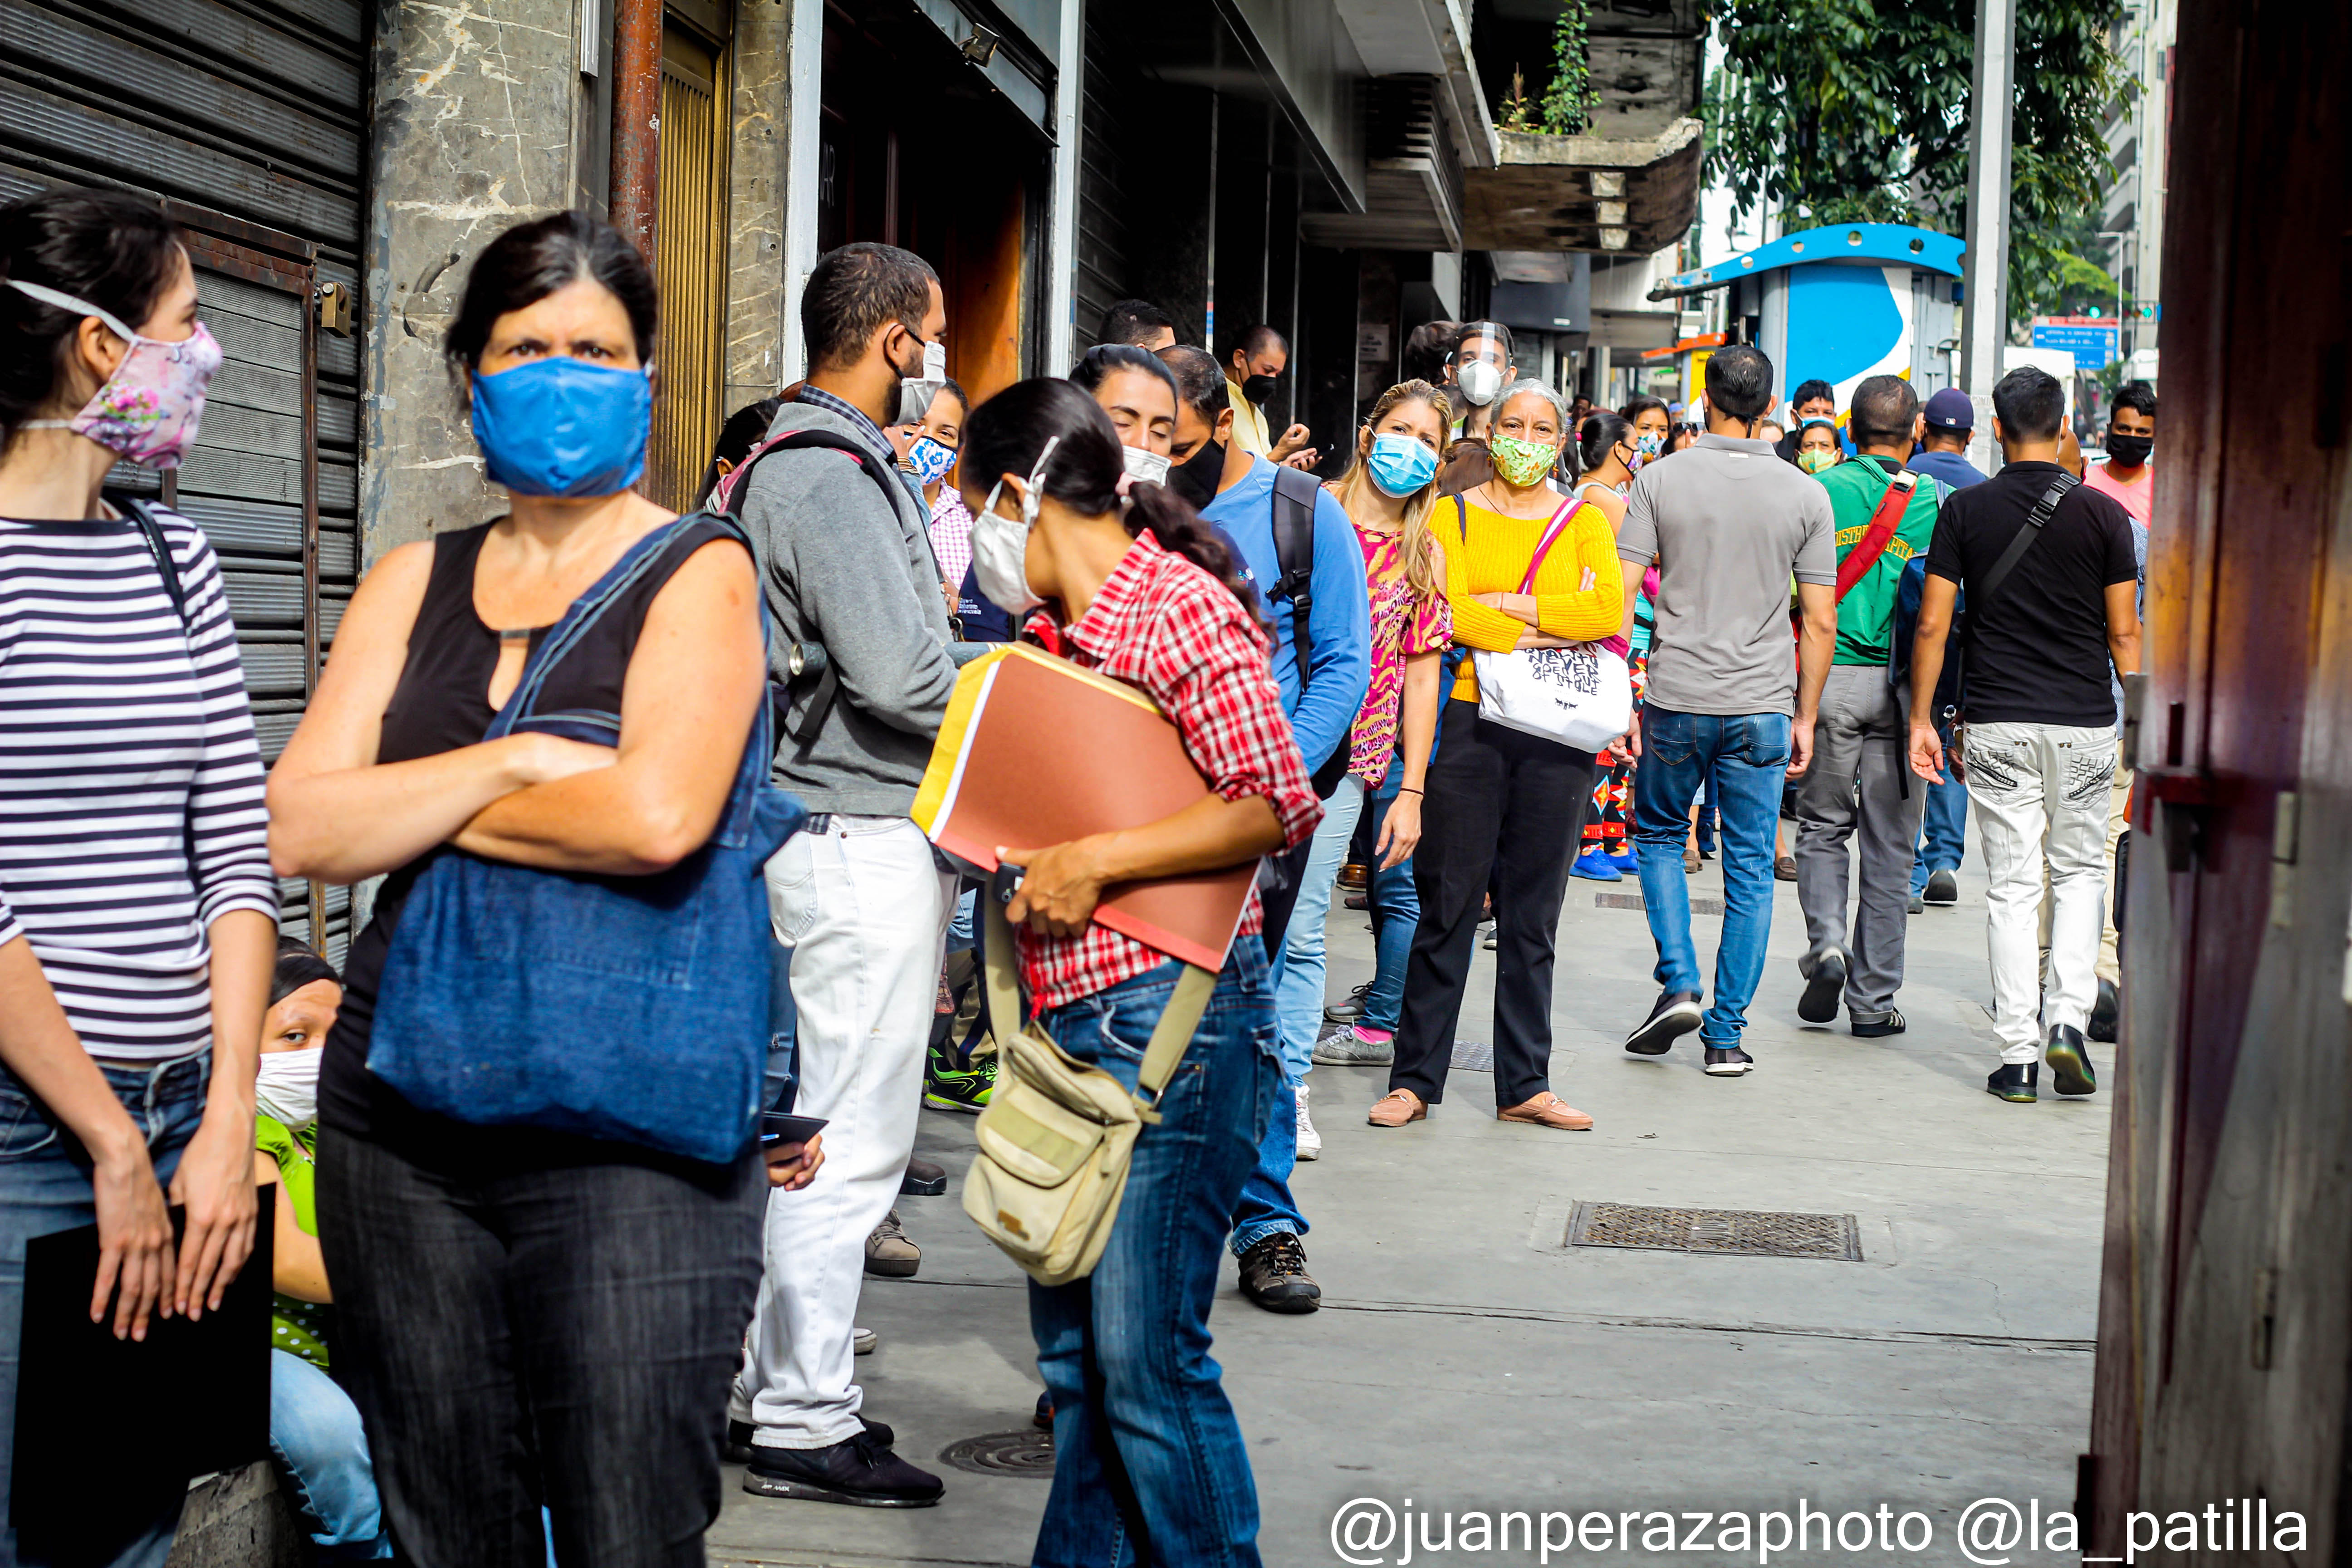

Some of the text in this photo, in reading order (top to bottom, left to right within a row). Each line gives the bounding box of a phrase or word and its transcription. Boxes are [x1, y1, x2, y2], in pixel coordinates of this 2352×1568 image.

[1834, 524, 1870, 547] DISTRI
[1528, 655, 1601, 682] NEVER
[1532, 671, 1550, 682] OF
[1557, 675, 1597, 696] STYLE
[1574, 674, 1600, 689] OUT
